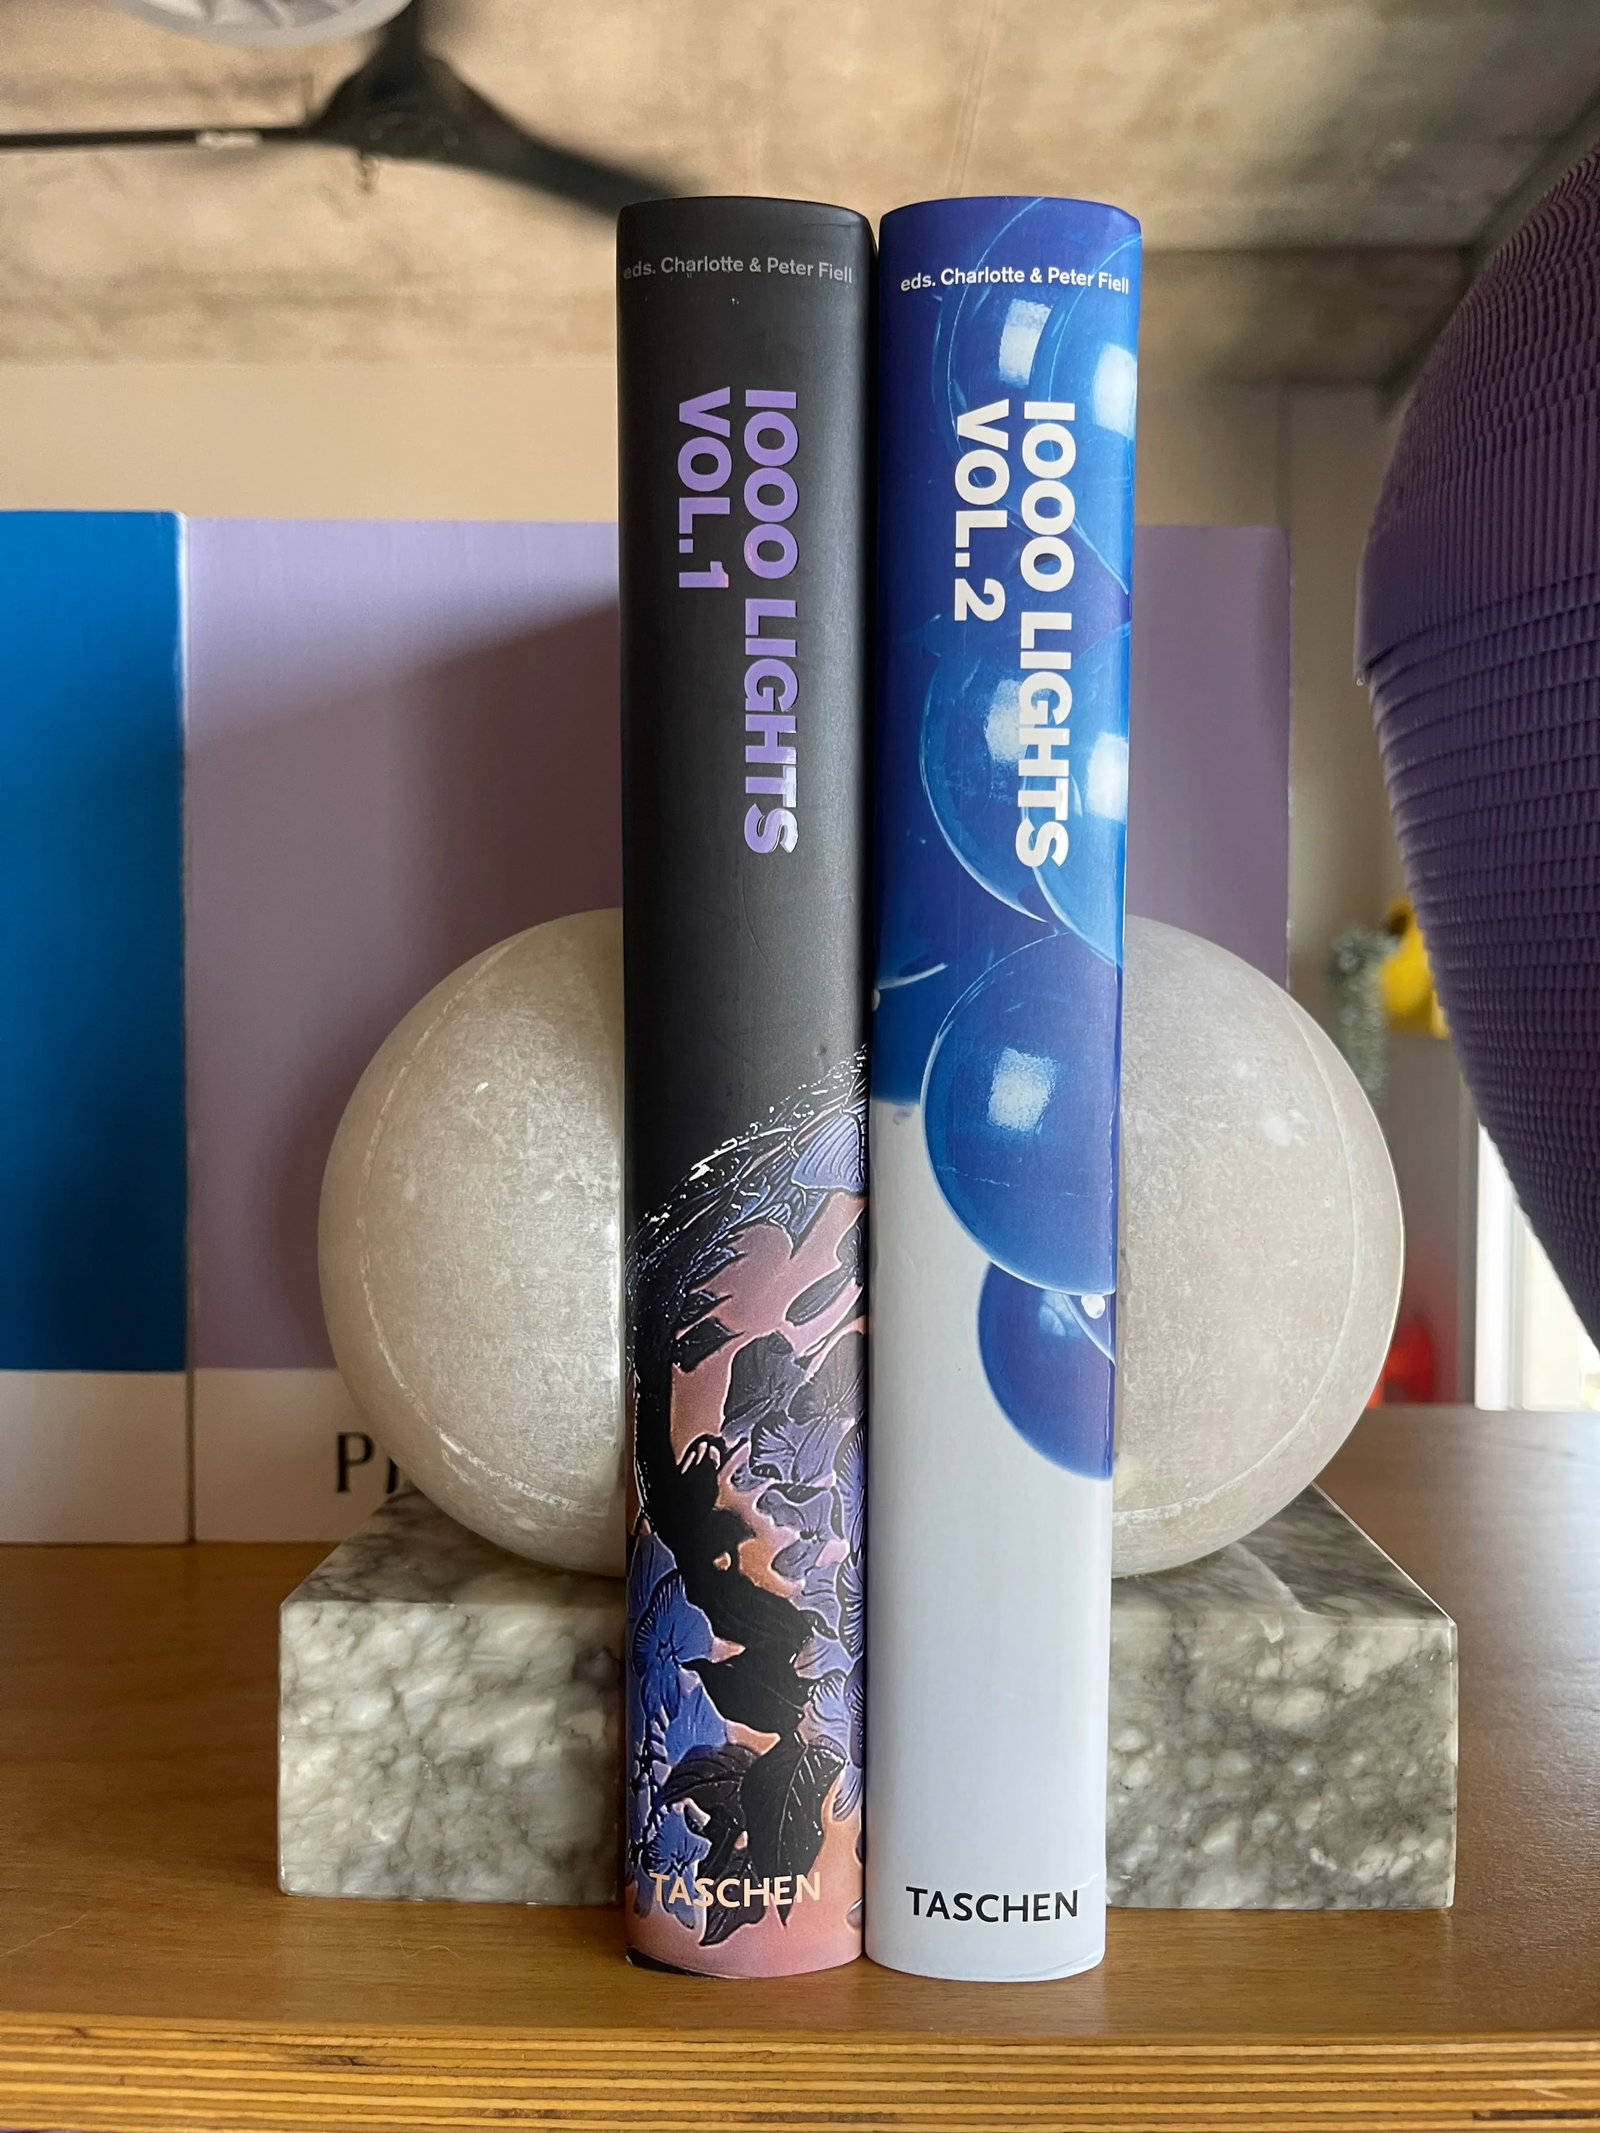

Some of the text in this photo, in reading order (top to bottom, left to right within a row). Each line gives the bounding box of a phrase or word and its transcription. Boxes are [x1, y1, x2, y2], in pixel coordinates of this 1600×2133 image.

[622, 256, 854, 284] eds. Charlotte & Peter Fiell
[900, 266, 1130, 295] eds. Charlotte & Peter Fiell
[743, 598, 799, 853] LIGHTS
[1015, 612, 1073, 867] LIGHTS
[649, 1872, 821, 1908] TASCHEN
[905, 1886, 1080, 1923] TASCHEN
